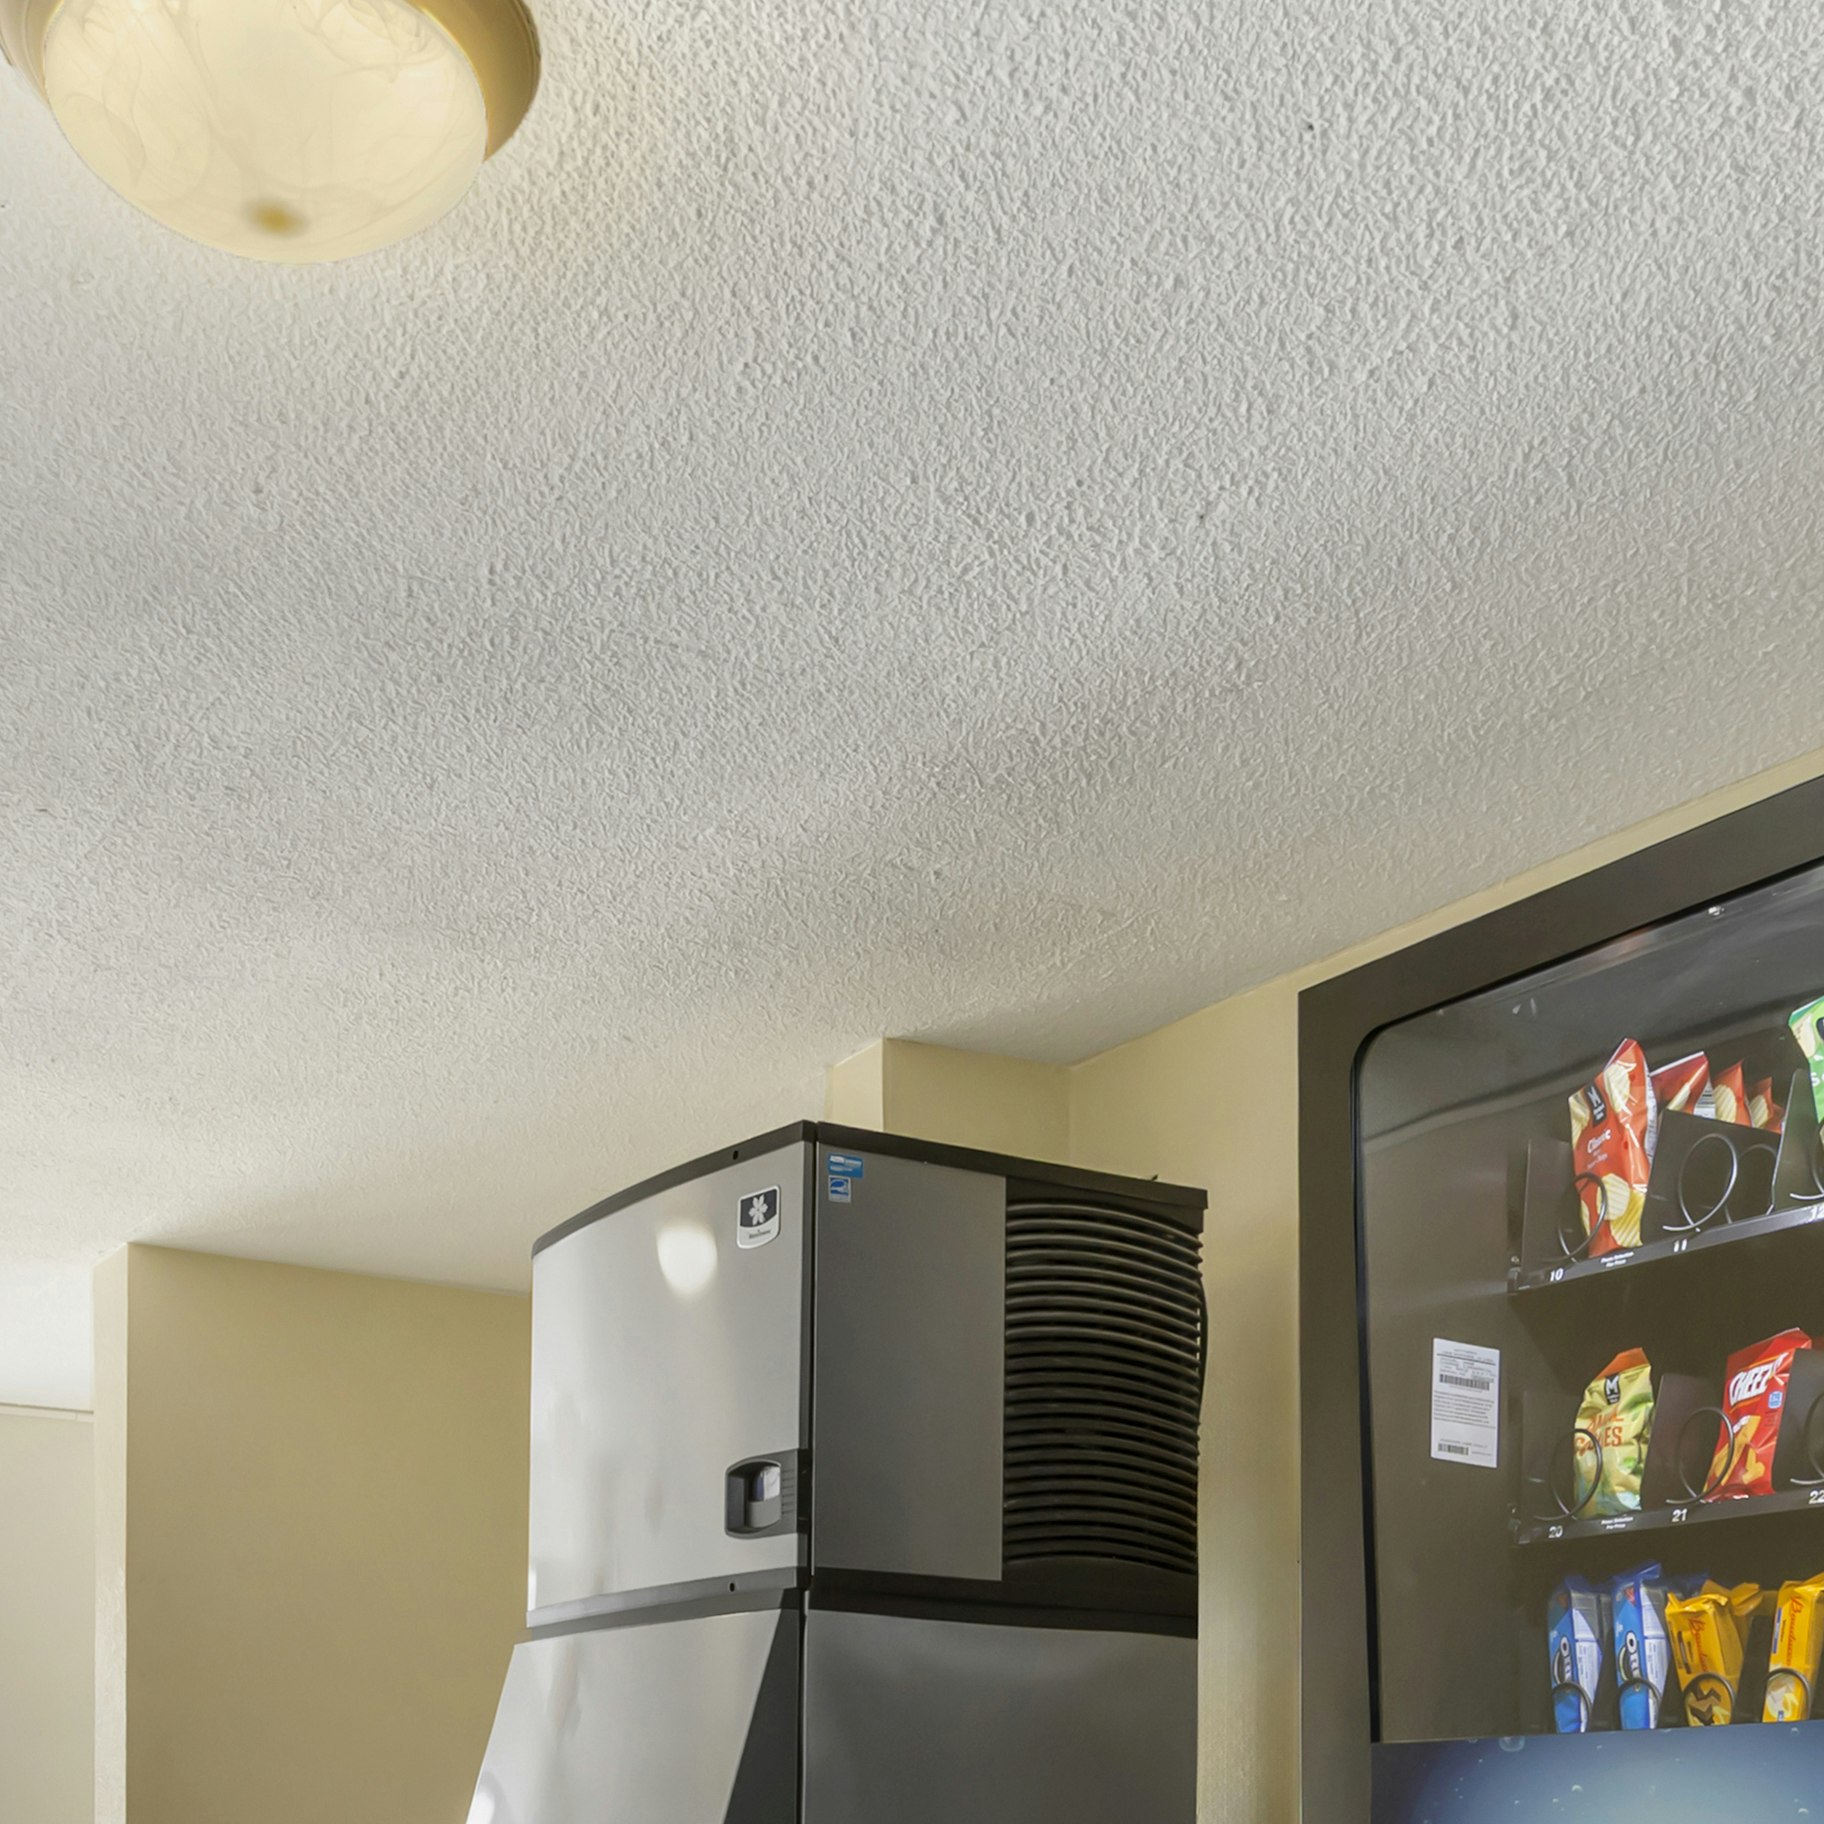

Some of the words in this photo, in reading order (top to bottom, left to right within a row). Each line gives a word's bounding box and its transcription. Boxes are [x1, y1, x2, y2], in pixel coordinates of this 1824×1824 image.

[1673, 1239, 1688, 1253] 11
[1550, 1268, 1564, 1282] 10
[1671, 1508, 1688, 1523] 21
[1548, 1525, 1564, 1539] 20
